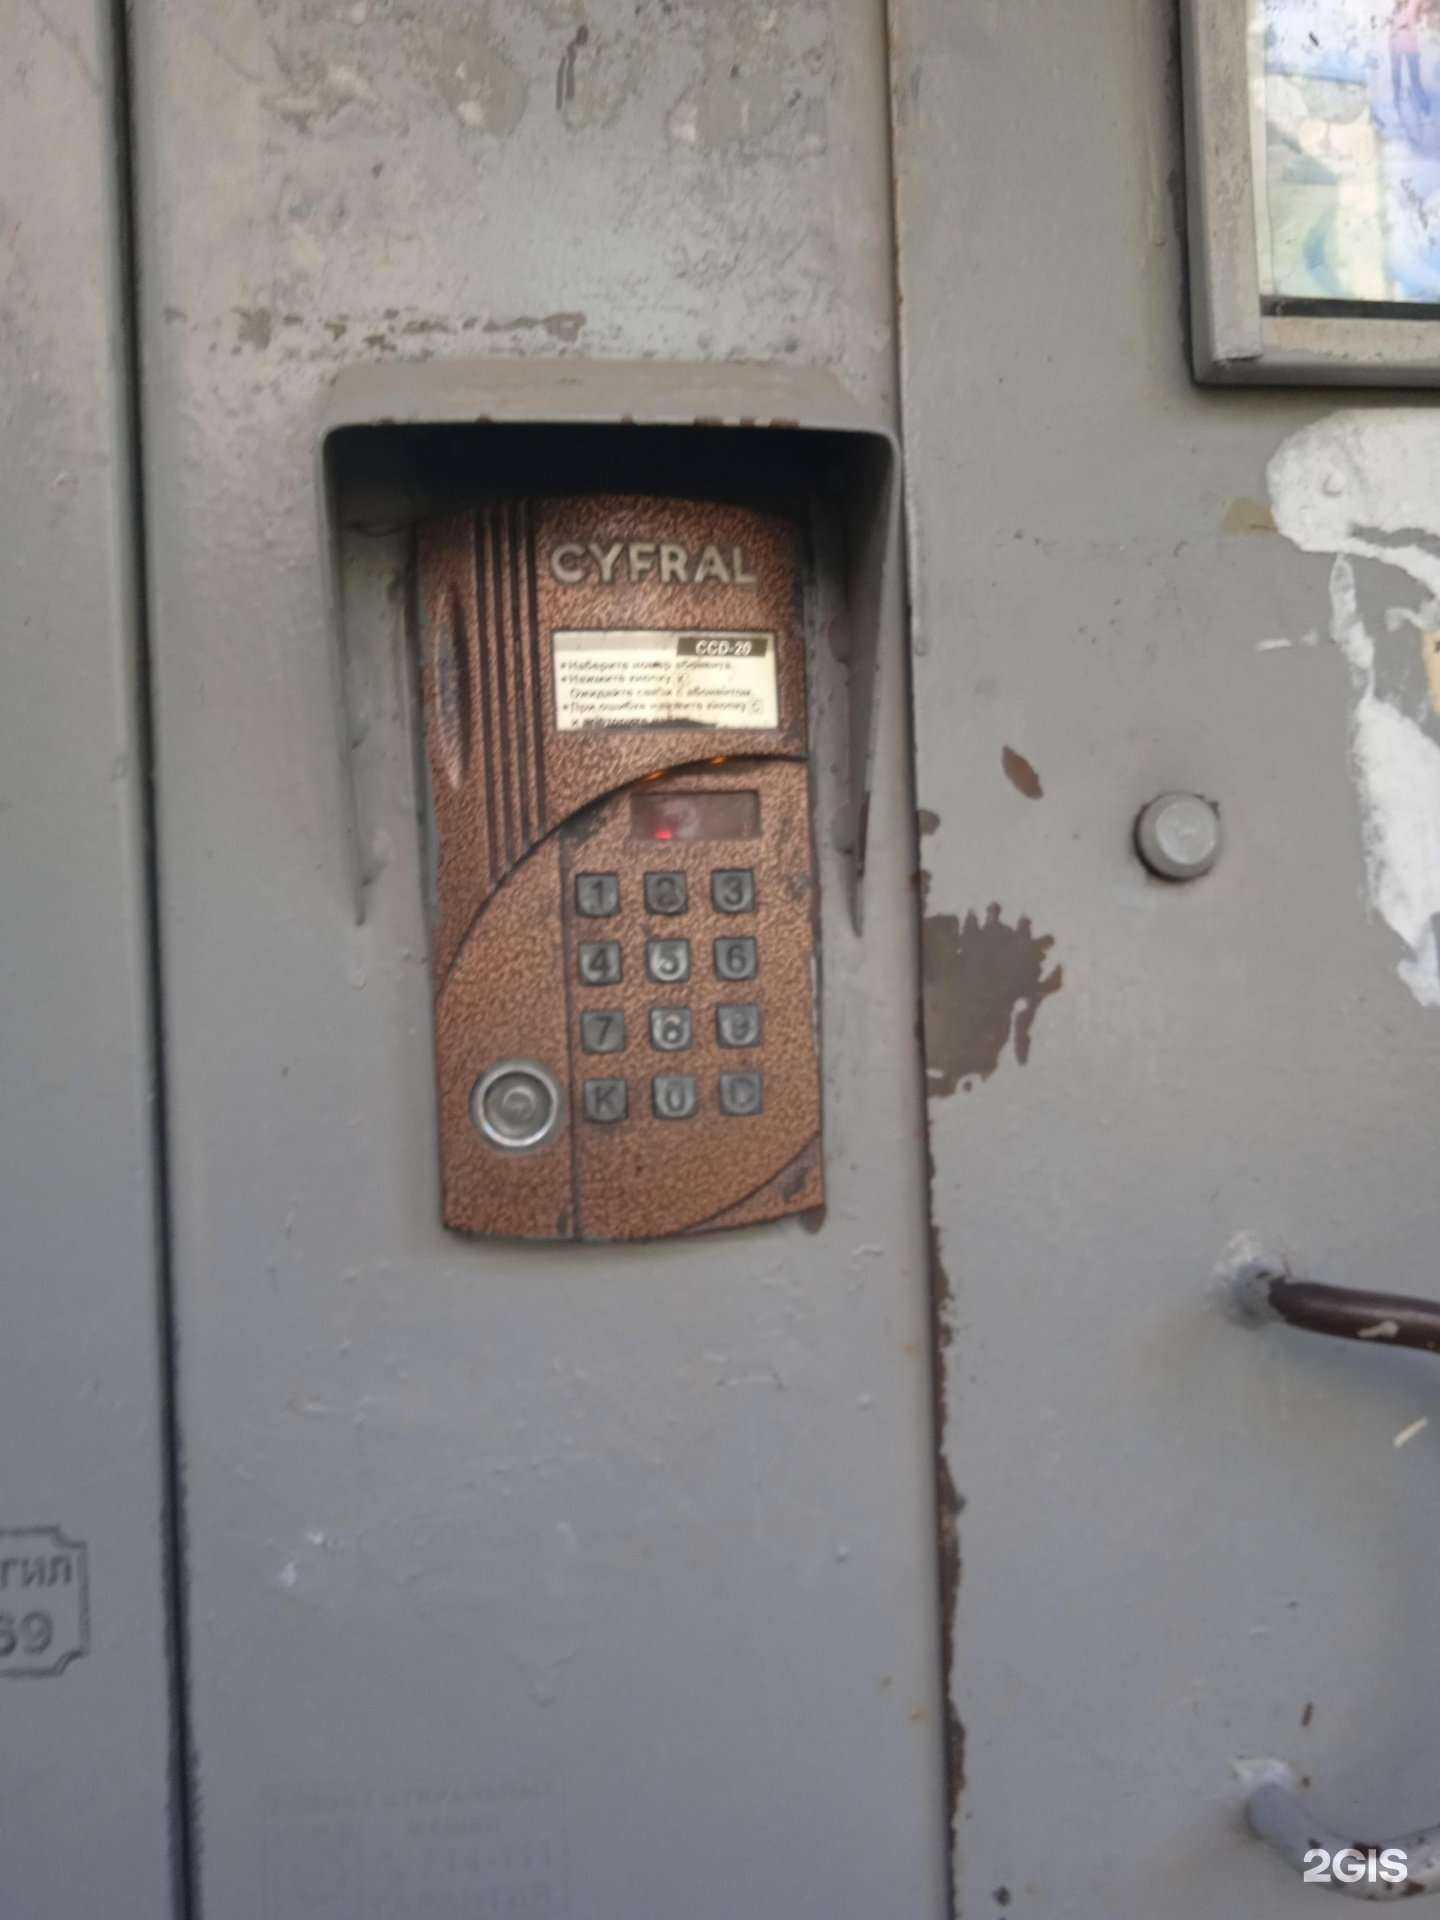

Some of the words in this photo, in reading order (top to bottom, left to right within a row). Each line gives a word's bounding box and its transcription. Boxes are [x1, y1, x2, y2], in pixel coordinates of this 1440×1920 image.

[551, 542, 758, 584] CYFRAL
[655, 876, 677, 907] 2
[722, 875, 744, 906] 3
[588, 947, 611, 976] 4
[657, 946, 680, 976] 5
[724, 943, 746, 972] 6
[595, 1016, 614, 1044] 7
